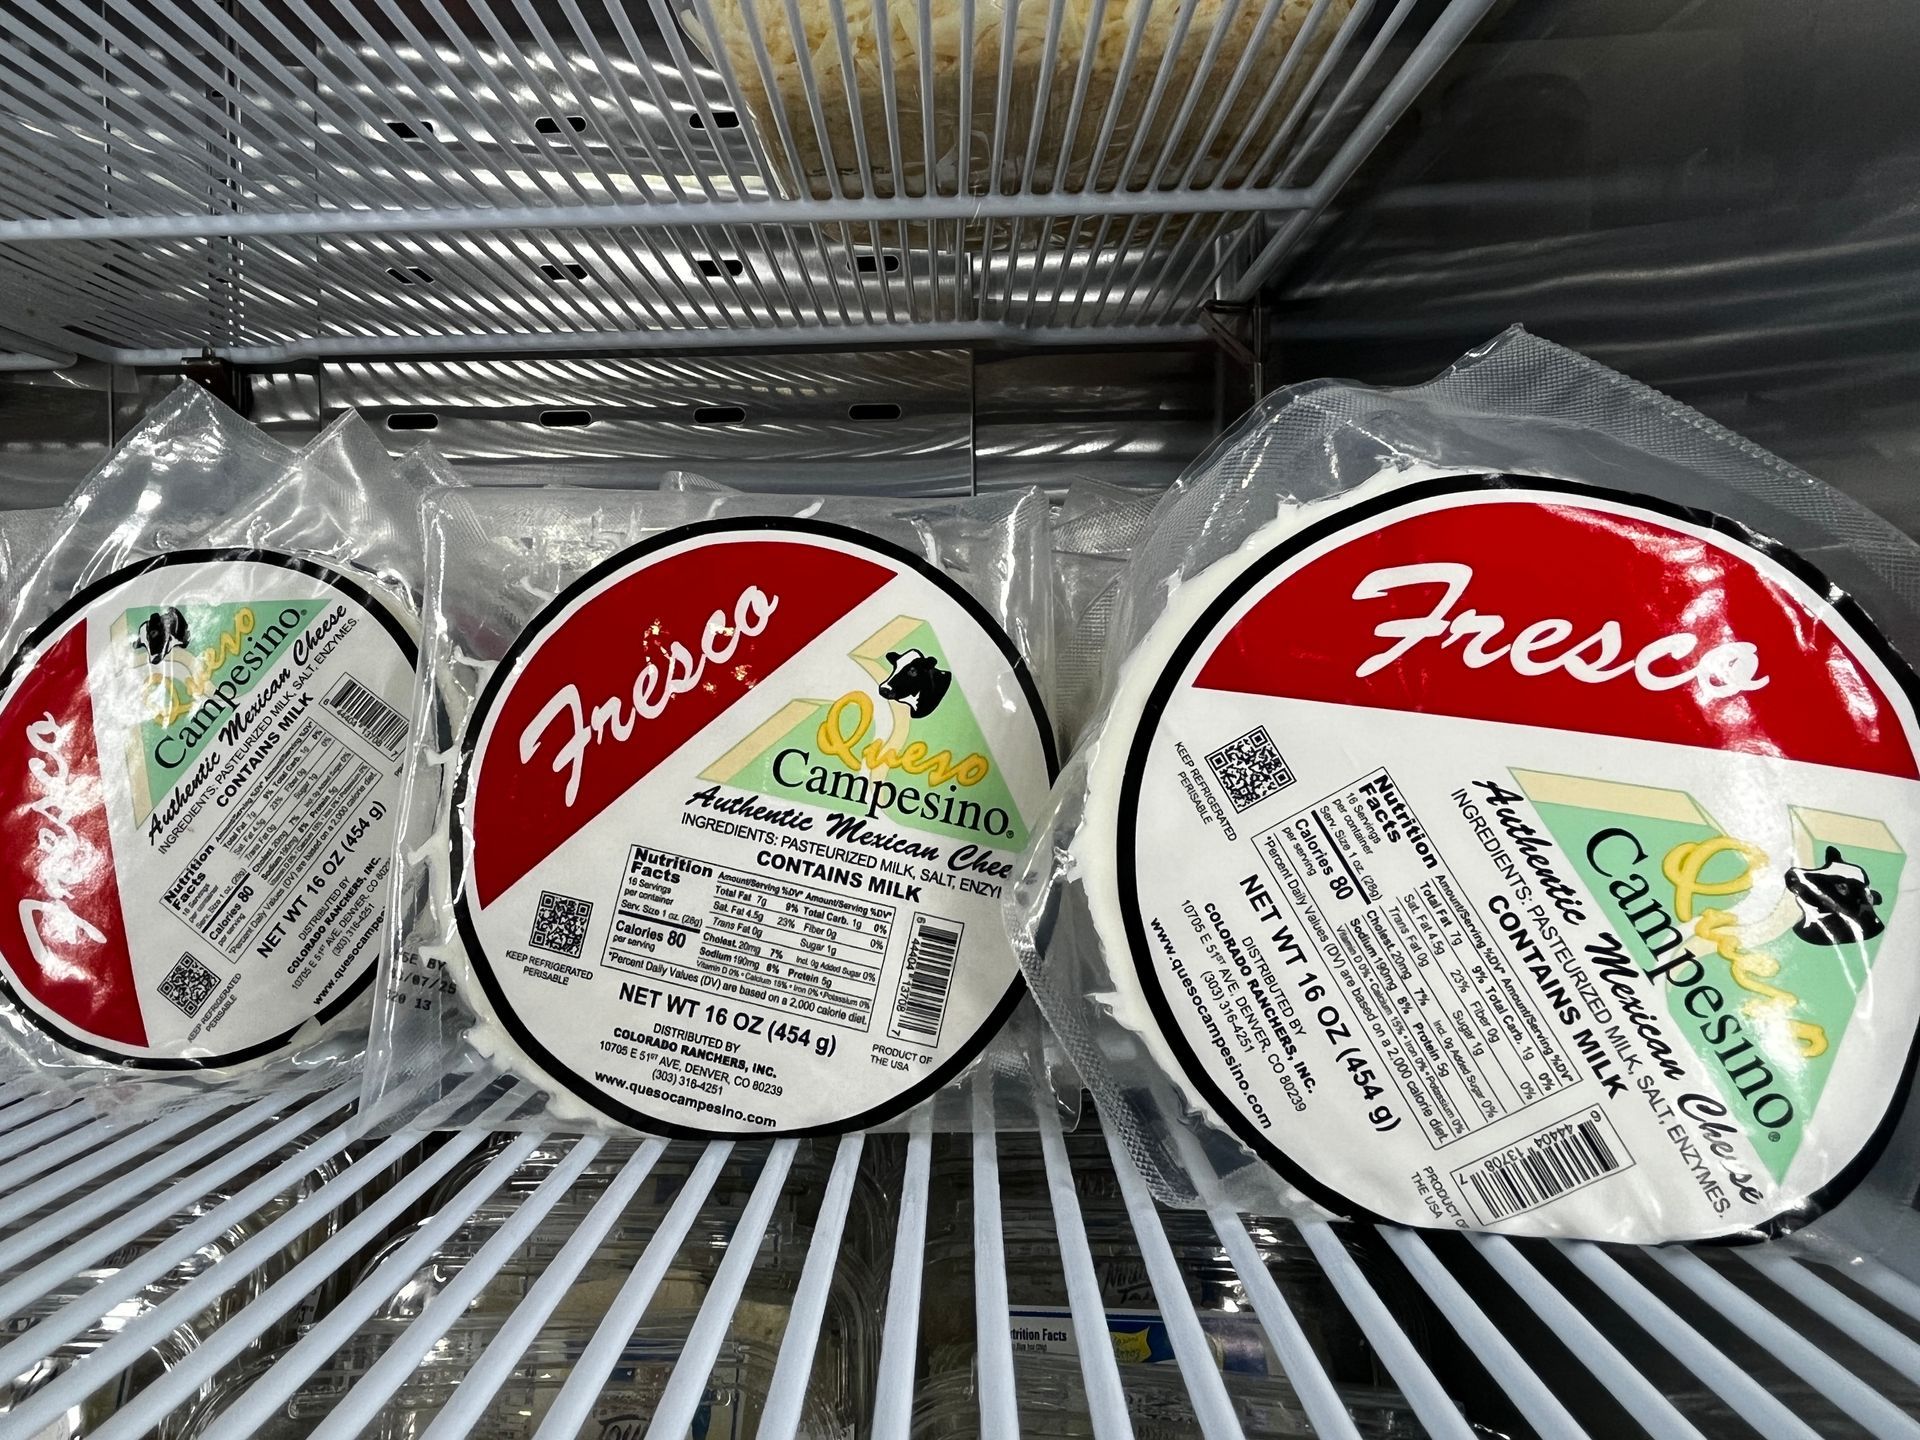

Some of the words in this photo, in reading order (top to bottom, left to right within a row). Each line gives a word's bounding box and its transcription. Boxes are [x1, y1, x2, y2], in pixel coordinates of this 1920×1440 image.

[1352, 562, 1770, 699] Fresco
[148, 751, 220, 846] Authentic
[218, 668, 290, 746] Mexican
[293, 605, 346, 666] Cheese
[519, 584, 779, 807] Fresco
[216, 731, 280, 807] CONTAINS
[277, 692, 313, 731] MILK
[816, 690, 989, 789] Queso
[1174, 741, 1194, 767] KEEP
[1190, 768, 1237, 841] REFRIGERATED
[1177, 771, 1213, 824] PERISABLE
[1331, 798, 1347, 813] per
[1343, 814, 1373, 854] container
[1353, 804, 1380, 844] Servings
[1358, 782, 1400, 843] Facts
[1372, 774, 1437, 869] Nutrition
[634, 847, 712, 877] Nutrition
[681, 812, 778, 845] INGREDIENTS:
[780, 835, 877, 868] PASTEURIZED
[879, 858, 915, 880] MILK,
[920, 868, 956, 889] SALT,
[684, 785, 813, 831] Authentic
[826, 812, 939, 861] Mexican
[947, 844, 1013, 879] Chee
[1281, 826, 1297, 841] per
[1293, 842, 1316, 876] serving
[1294, 818, 1333, 875] Calories
[1329, 875, 1353, 900] 80
[1319, 805, 1336, 826] Serv.
[1334, 829, 1350, 850] Size
[1360, 875, 1382, 901] (28g)
[163, 844, 215, 903] Nutrition
[171, 872, 206, 910] Facts
[256, 921, 286, 958] NET
[282, 894, 307, 922] WT
[306, 875, 325, 894] 16
[322, 849, 345, 875] OZ
[340, 817, 370, 852] (454
[368, 800, 386, 820] g)
[630, 860, 680, 883] Facts
[756, 850, 863, 888] CONTAINS
[868, 876, 922, 903] MILK
[209, 902, 241, 940] Calories
[237, 885, 254, 902] 80
[615, 920, 663, 941] Calories
[667, 930, 686, 948] 80
[1471, 780, 1586, 925] Authentic
[1584, 932, 1685, 1080] Mexican
[505, 950, 528, 961] KEEP
[528, 955, 593, 980] REFRIGERATED
[1204, 903, 1251, 976] COLORADO
[1246, 978, 1297, 1061] RANCHERS,
[1293, 1061, 1315, 1093] INC.
[1239, 874, 1282, 922] NET
[1271, 925, 1307, 965] WT
[1297, 972, 1325, 1002] 16
[1317, 1005, 1351, 1045] OZ
[1335, 1047, 1384, 1100] (454
[1368, 1105, 1401, 1131] g)
[1241, 936, 1294, 1017] DISTRIBUTED
[1288, 1018, 1306, 1034] BY
[1287, 878, 1307, 905] Daily
[1304, 905, 1328, 942] Values
[1322, 943, 1345, 968] (DV)
[1339, 969, 1355, 987] are
[1351, 987, 1378, 1021] based
[1372, 1023, 1385, 1037] on
[1381, 1038, 1390, 1047] a
[1386, 1047, 1412, 1079] 2,000
[1406, 1080, 1432, 1117] calorie
[1403, 894, 1419, 914] Sat.
[1416, 914, 1432, 933] Fat
[1428, 933, 1445, 955] 4.5g
[1449, 969, 1469, 993] 23%
[1469, 1000, 1491, 1026] Fiber
[1486, 1027, 1500, 1043] 0g
[1519, 1081, 1536, 1100] 0%
[1419, 881, 1441, 909] Total
[1435, 908, 1452, 927] Fat
[1450, 930, 1462, 946] 7g
[1471, 965, 1487, 984] 9%
[1485, 985, 1508, 1014] Total
[1502, 1015, 1522, 1044] Carb.
[1522, 1046, 1534, 1060] 1g
[1538, 1072, 1555, 1091] 0%
[1434, 875, 1486, 949] Amount/Serving
[1500, 978, 1553, 1055] Amount/Serving
[1450, 788, 1532, 905] INGREDIENTS:
[1526, 904, 1612, 1024] PASTEURIZED
[1604, 1025, 1642, 1075] MILK,
[1636, 1075, 1674, 1124] SALT,
[1666, 1124, 1730, 1218] ENZYMES.
[1488, 895, 1580, 1025] CONTAINS
[1572, 1028, 1628, 1099] MILK
[619, 982, 662, 1008] NET
[667, 993, 700, 1018] WT
[705, 1005, 728, 1025] 16
[733, 1012, 764, 1035] OZ
[767, 1020, 810, 1046] (454
[815, 1034, 836, 1057] g)
[653, 1023, 723, 1049] DISTRIBUTED
[724, 1041, 740, 1053] BY
[1147, 917, 1275, 1131] www.quesocampesino.com
[1181, 899, 1205, 932] 10705
[1199, 933, 1211, 944] E
[1218, 968, 1239, 996] AVE,
[1235, 996, 1270, 1053] DENVER,
[1267, 1053, 1284, 1073] CO
[1279, 1075, 1306, 1111] 80239
[1199, 970, 1224, 1000] (303)
[1218, 1000, 1254, 1052] 316-4251
[613, 1027, 677, 1052] COLORADO
[680, 1044, 748, 1073] RANCHERS,
[752, 1062, 776, 1078] INC.
[630, 1047, 637, 1058] E
[658, 1056, 681, 1071] AVE,
[684, 1062, 730, 1084] DENVER,
[733, 1075, 750, 1088] CO
[752, 1080, 782, 1096] 80239
[652, 1068, 677, 1085] (303)
[678, 1075, 722, 1095] 316-4251
[870, 1054, 888, 1066] THE
[890, 1060, 909, 1071] USA
[872, 1043, 918, 1061] PRODUCT
[919, 1055, 932, 1064] OF
[593, 1070, 778, 1129] www.quesocampesino.com
[1411, 1171, 1429, 1195] THE
[1424, 1195, 1442, 1218] USA
[1422, 1166, 1461, 1217] PRODUCT
[1010, 1328, 1040, 1341] trition
[1042, 1328, 1067, 1342] Facts
